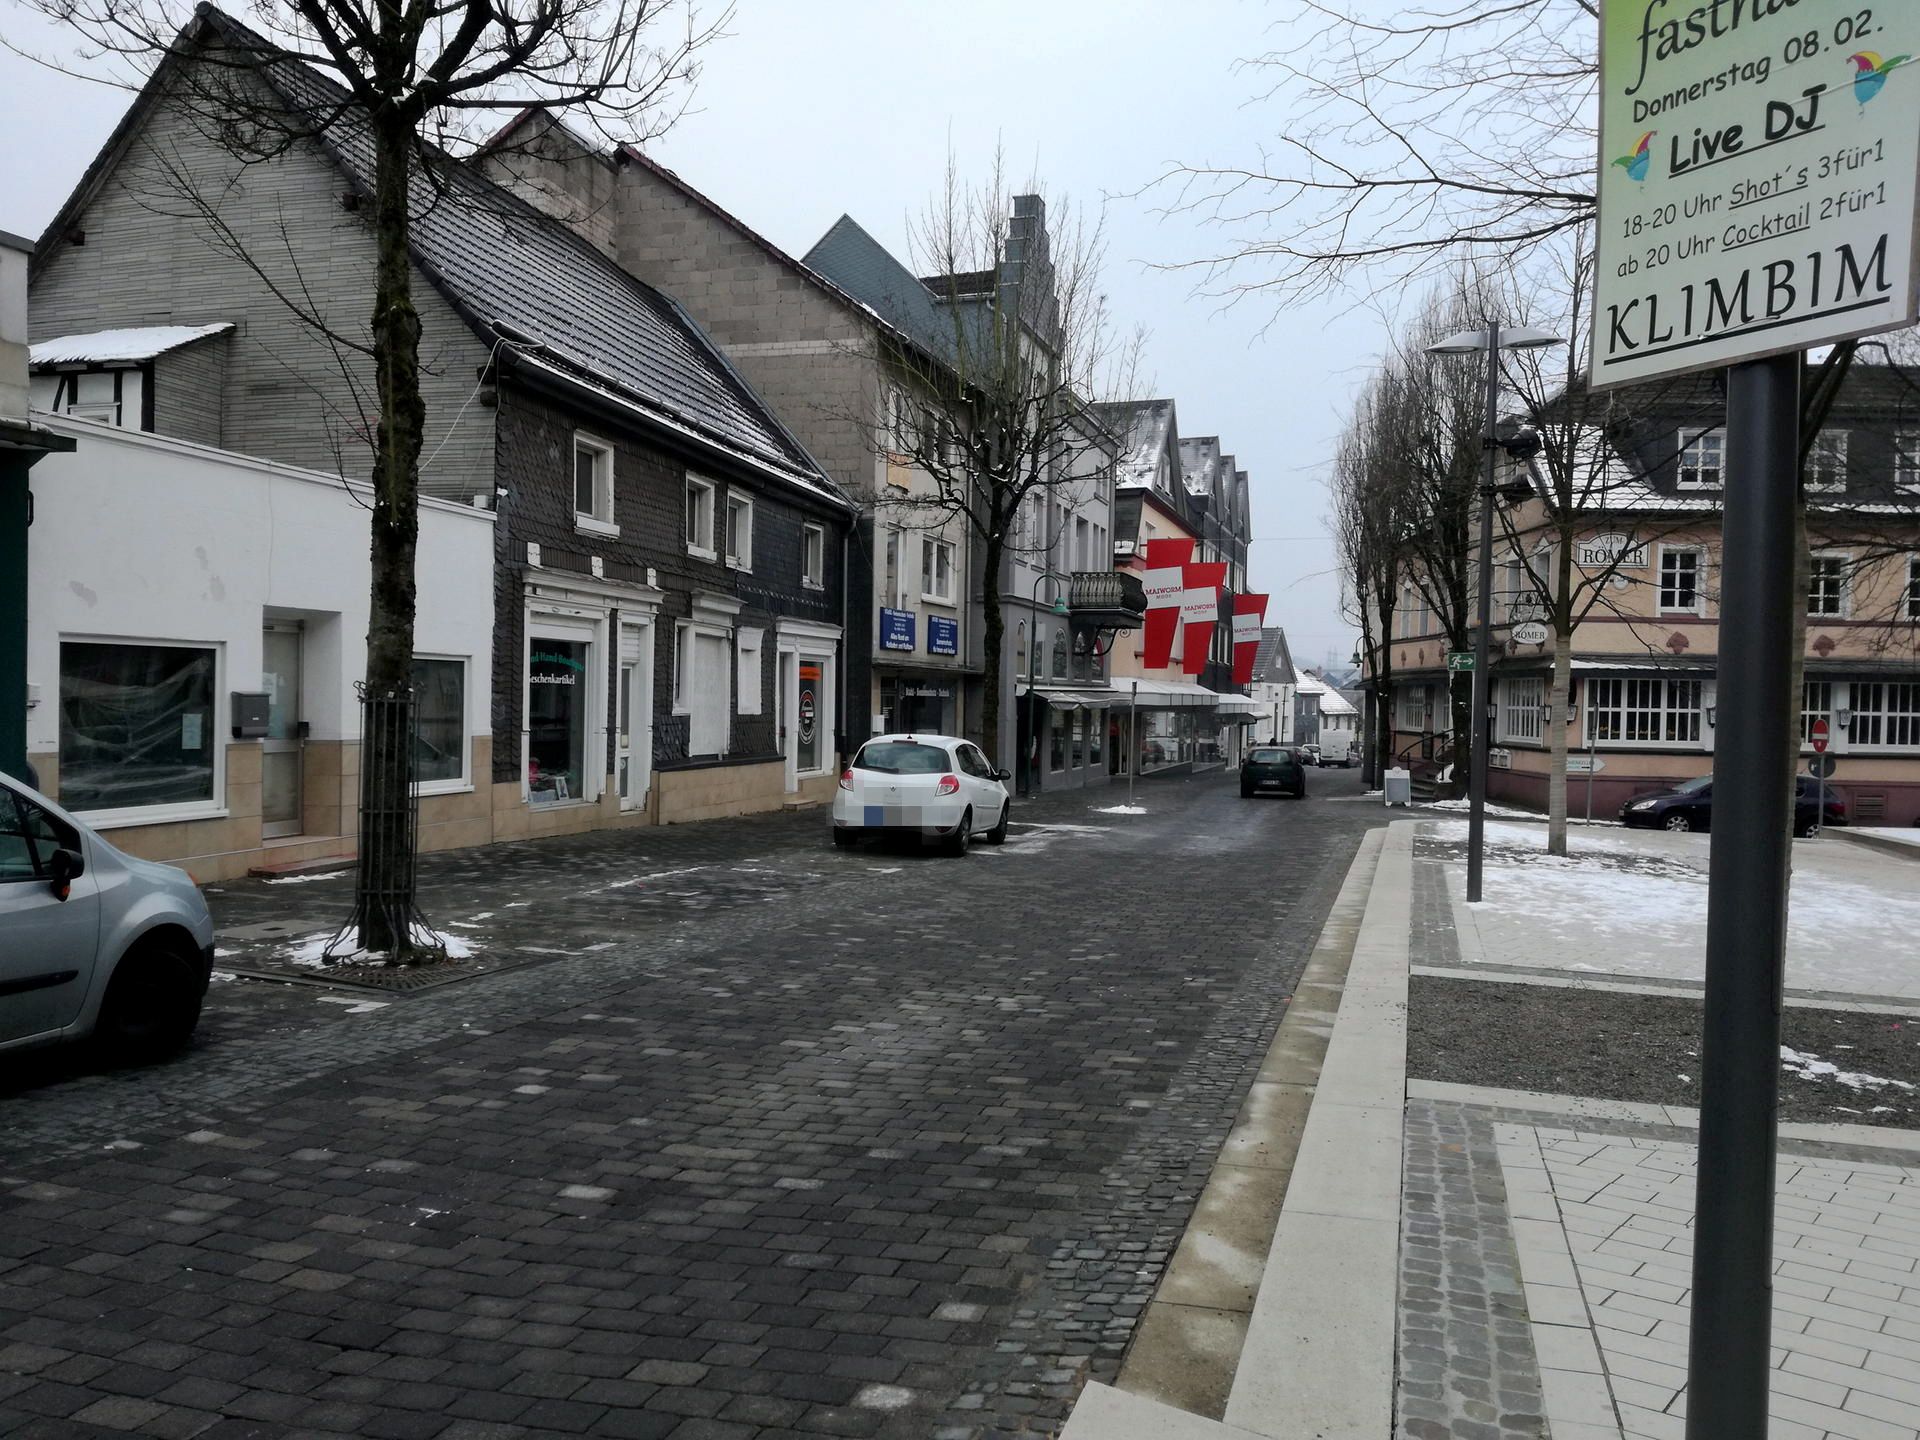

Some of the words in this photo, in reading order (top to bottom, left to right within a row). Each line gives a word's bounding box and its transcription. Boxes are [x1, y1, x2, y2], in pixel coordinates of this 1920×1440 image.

[1633, 56, 1771, 123] Donnerstag
[1669, 124, 1744, 174] Live
[1765, 83, 1827, 140] DJ
[1617, 254, 1638, 278] ab
[1645, 244, 1670, 270] 20
[1677, 234, 1716, 261] Uhr
[1722, 202, 1811, 247] Cocktail
[1623, 203, 1677, 239] 18-20
[1684, 192, 1722, 220] Uhr
[1607, 233, 1893, 354] KLIMBIM
[1583, 546, 1643, 564] RÖMER
[1145, 586, 1182, 595] MAIWORM
